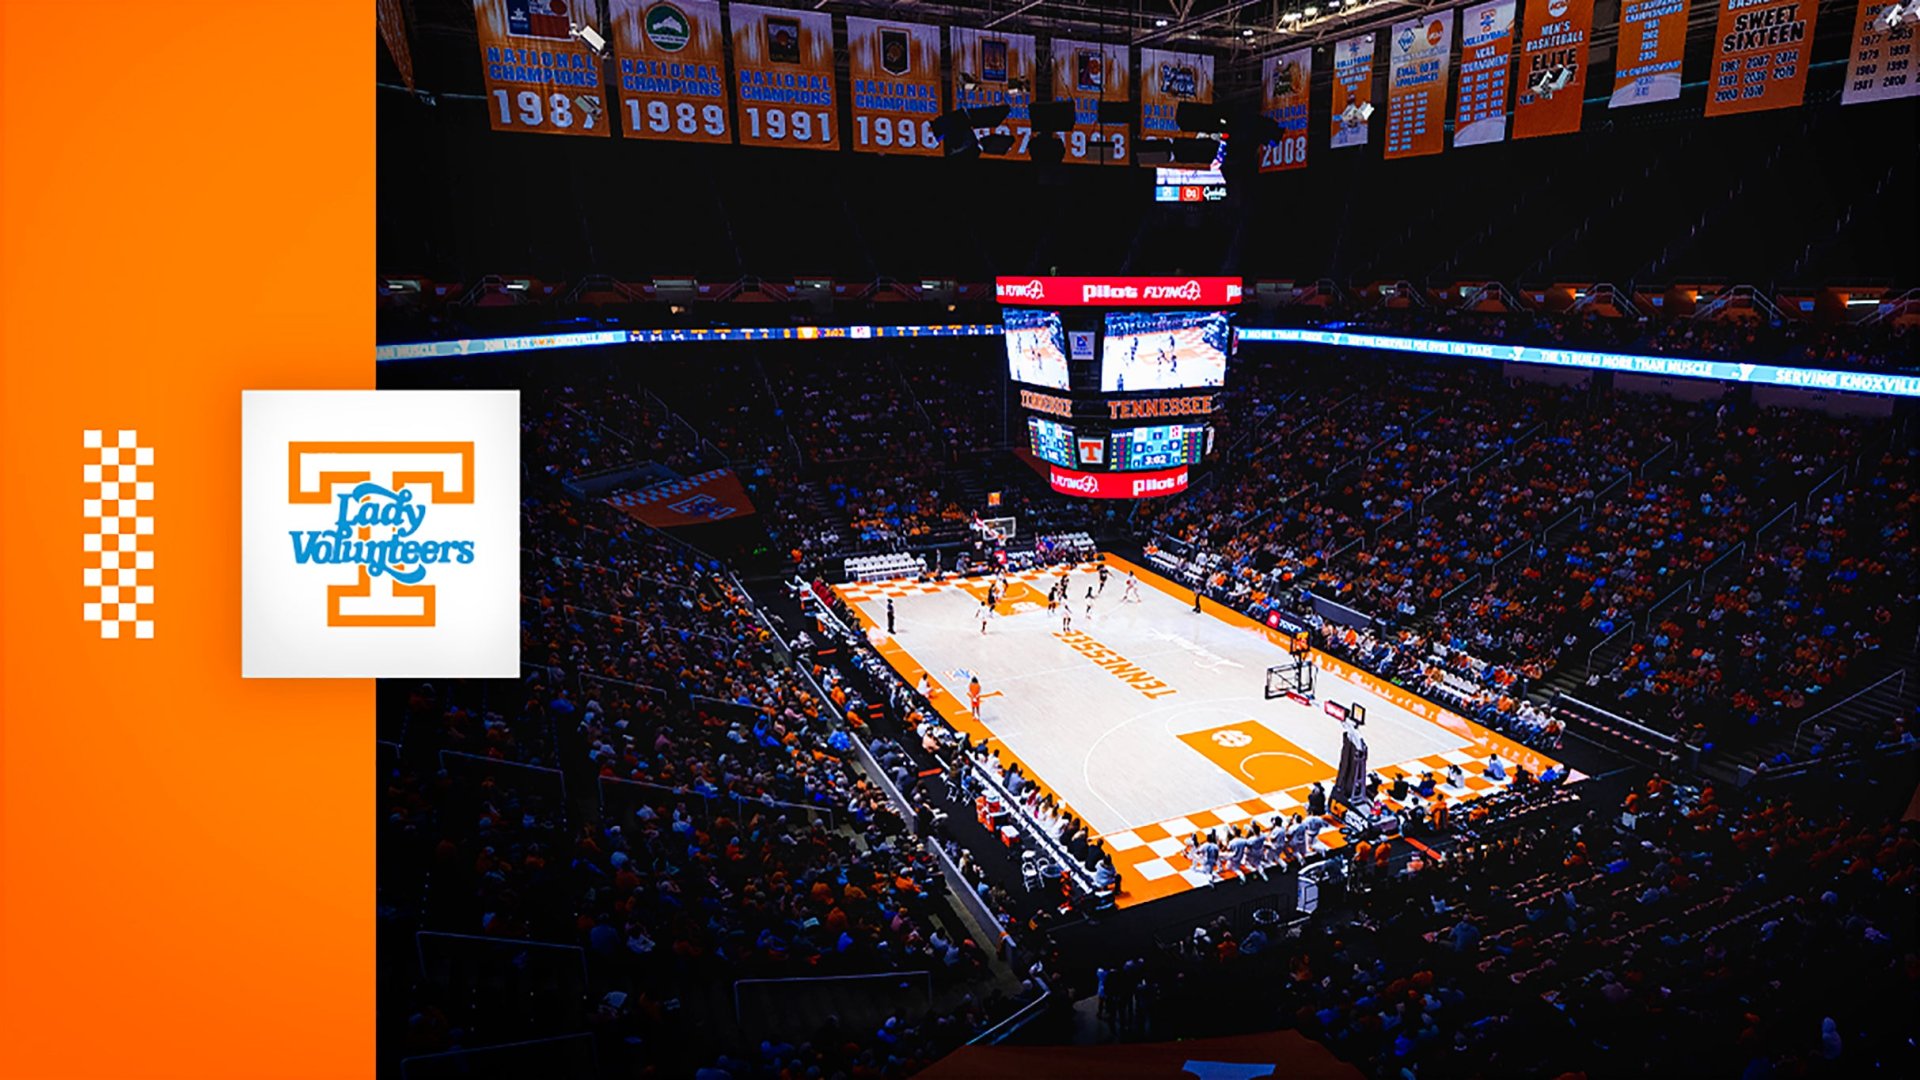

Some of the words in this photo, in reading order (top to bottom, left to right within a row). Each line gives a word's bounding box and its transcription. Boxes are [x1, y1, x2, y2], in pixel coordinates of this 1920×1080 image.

[1541, 21, 1571, 36] MEN'S
[1735, 3, 1799, 32] SWEET
[1464, 29, 1510, 46] VOLLEYBALL
[1526, 31, 1583, 52] BASKETBALL
[1722, 20, 1806, 53] SIXTEEN
[487, 47, 598, 71] NATIONAL
[621, 58, 721, 81] NATIONAL
[1532, 48, 1578, 71] ELITE
[489, 64, 599, 88] CHAMPIONS
[623, 75, 722, 97] CHAMPIONS
[740, 70, 832, 91] NATIONAL
[741, 85, 832, 106] CHAMPIONS
[855, 79, 938, 99] NATIONAL
[855, 94, 938, 113] CHAMPIONS
[625, 99, 725, 135] 1989
[746, 107, 831, 142] 1991
[856, 116, 939, 149] 1996
[1262, 136, 1307, 168] 2008
[1143, 286, 1188, 298] FLYING
[1634, 357, 1665, 372] THAN
[1668, 359, 1712, 375] MUSCLE
[1776, 369, 1837, 387] SERVING
[1840, 374, 1920, 396] KNOXVILL
[1021, 389, 1073, 418] TENNESSEE
[1107, 396, 1214, 419] TENNESSEE
[1080, 441, 1102, 461] T
[1052, 629, 1177, 700] TENNESSEE
